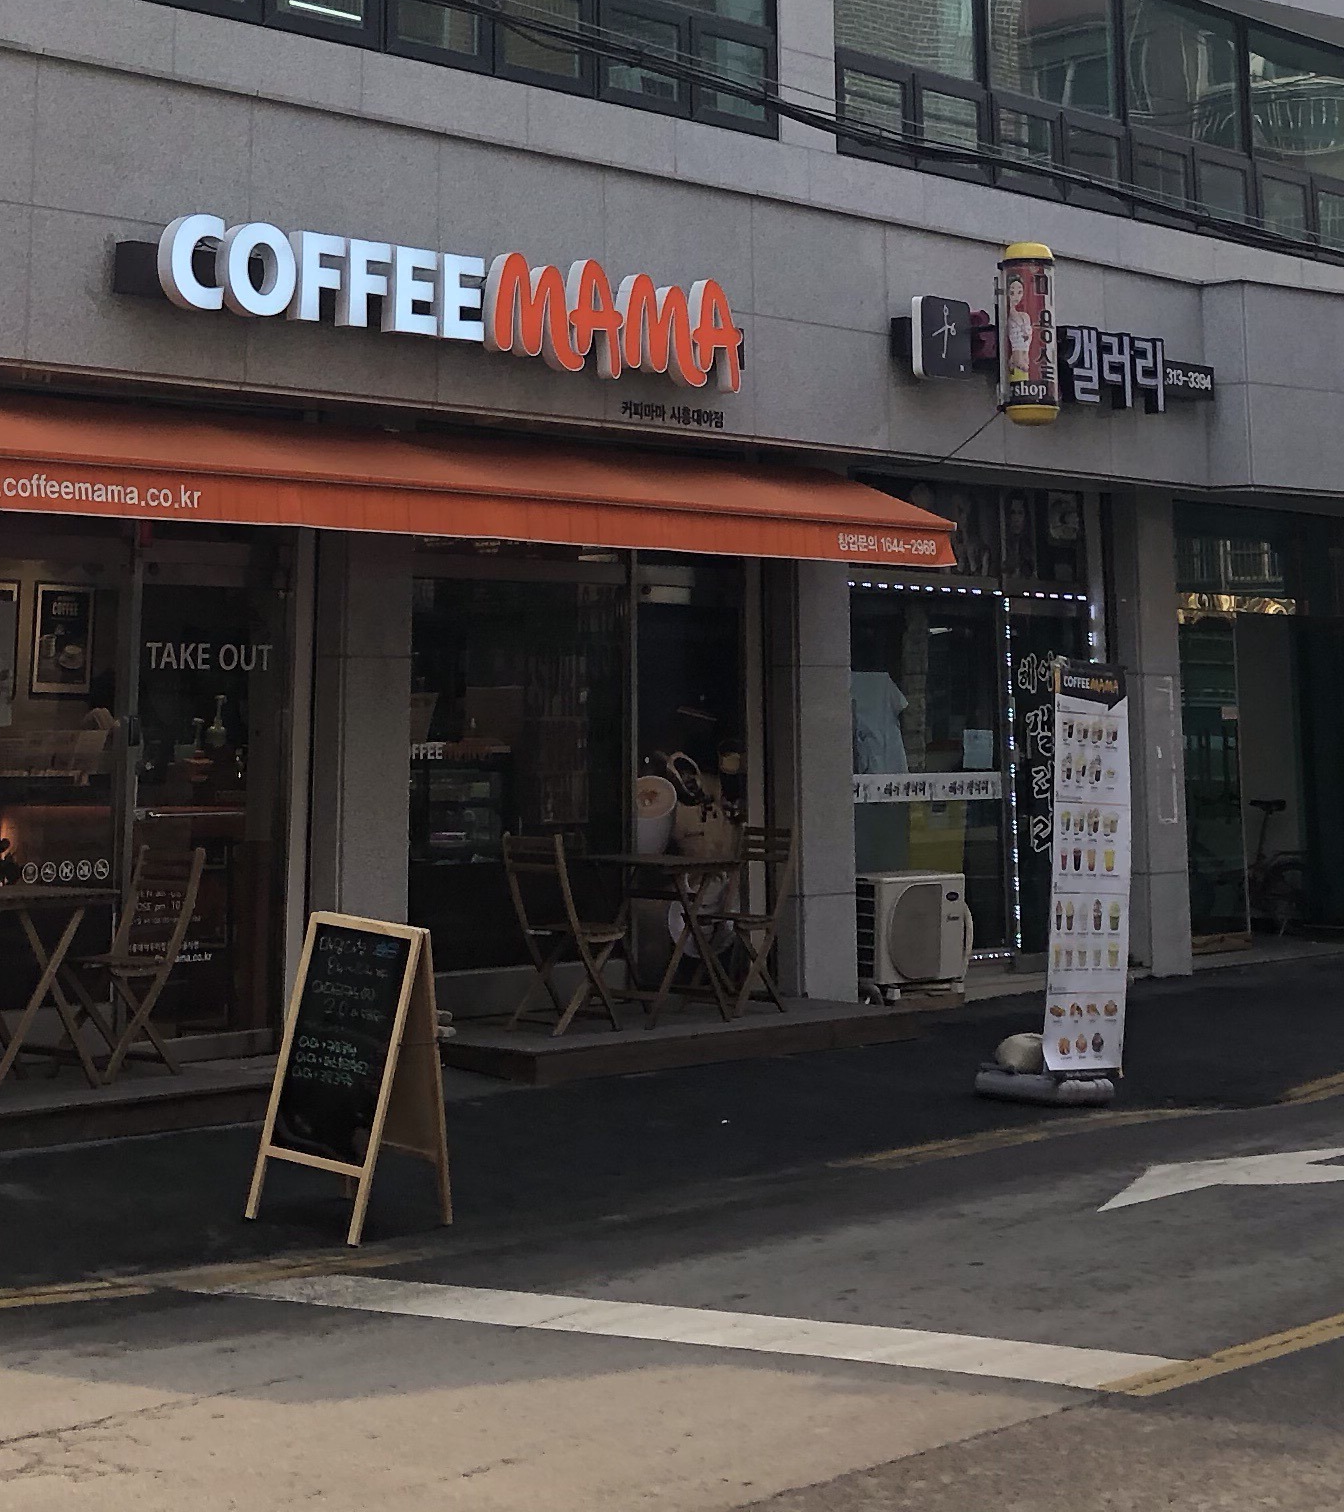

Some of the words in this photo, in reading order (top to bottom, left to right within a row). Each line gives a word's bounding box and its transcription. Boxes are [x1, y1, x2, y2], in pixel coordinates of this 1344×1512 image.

[158, 213, 486, 342] COFFEE
[484, 251, 743, 393] MAMA
[1066, 325, 1166, 414] 갤러리
[621, 400, 666, 422] 커피마마
[670, 405, 724, 429] 시흥대야점
[146, 642, 210, 670] TAKE
[218, 643, 273, 671] OUT
[1063, 675, 1090, 689] COFFEE
